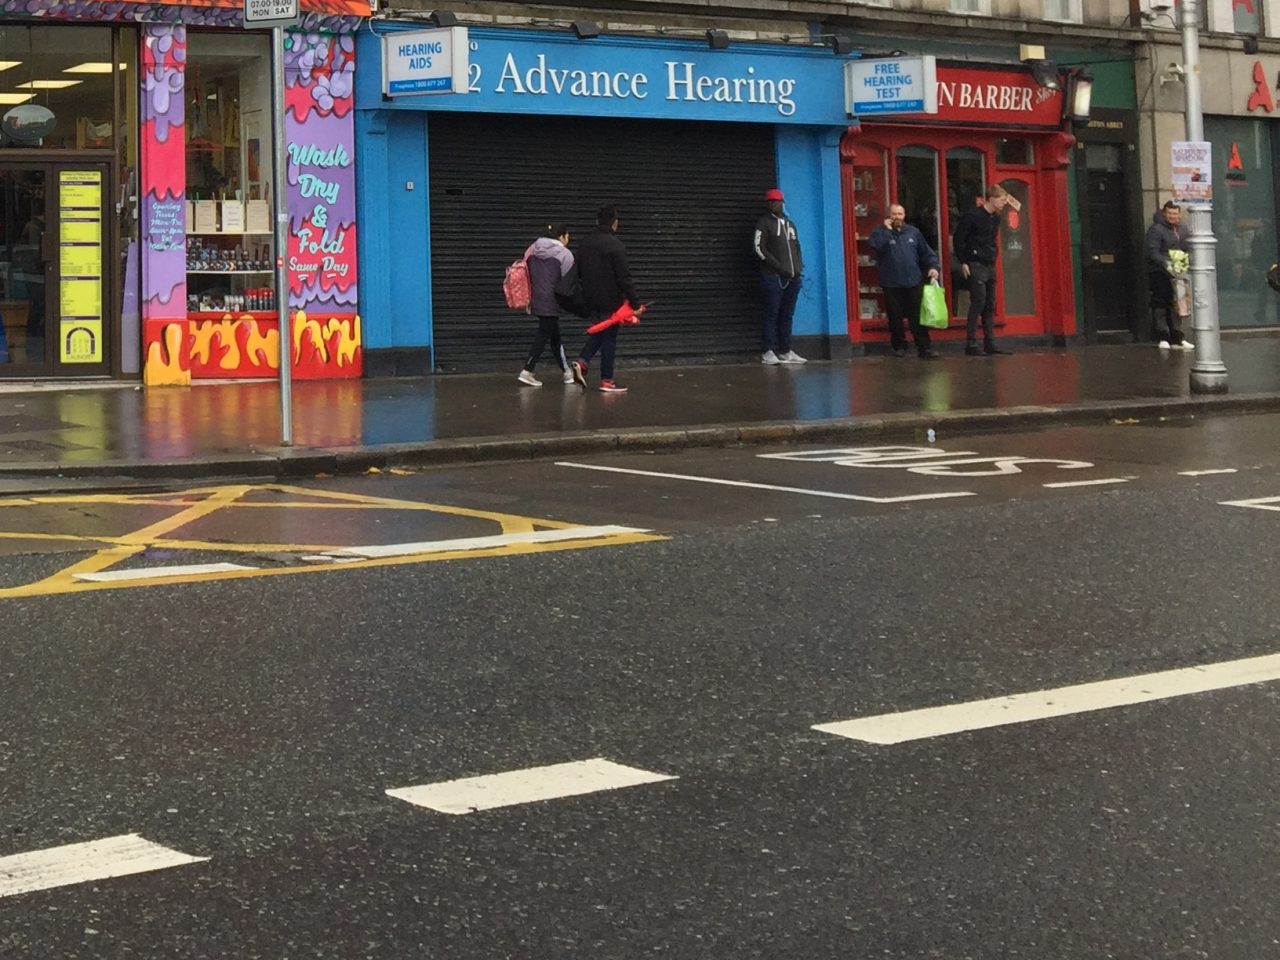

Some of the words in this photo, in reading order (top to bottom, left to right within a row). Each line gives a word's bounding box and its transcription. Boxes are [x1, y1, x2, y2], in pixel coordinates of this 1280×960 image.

[252, 9, 270, 17] MON
[275, 7, 291, 15] SAT
[398, 42, 442, 57] HEARING
[409, 57, 432, 70] AIDS
[874, 63, 900, 75] FREE
[495, 52, 648, 99] Advance
[664, 61, 796, 117] Hearing
[864, 75, 912, 87] HEARING
[876, 87, 901, 99] TEST
[959, 83, 1033, 112] BARBER
[288, 142, 350, 167] Wash
[297, 173, 340, 204] Dry
[311, 204, 328, 227] &
[297, 228, 344, 254] Fold
[289, 256, 318, 272] Same
[322, 257, 348, 276] Day
